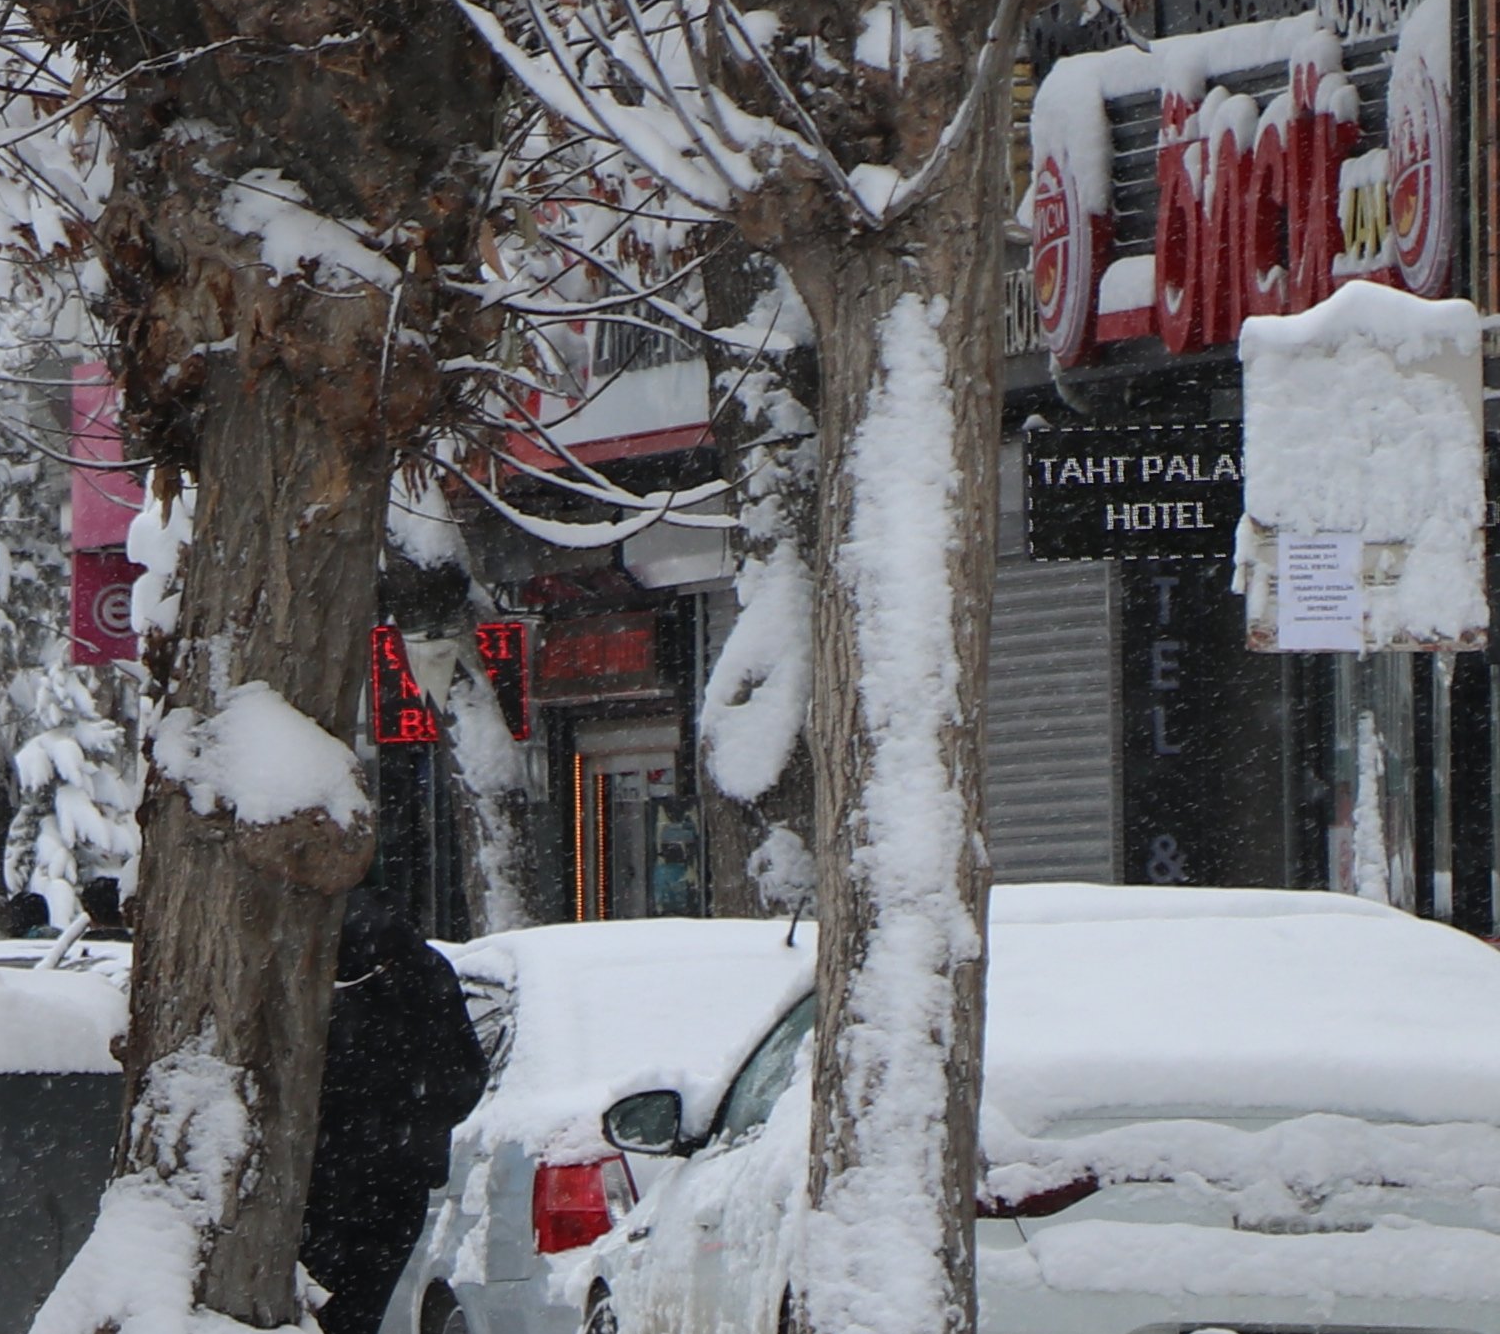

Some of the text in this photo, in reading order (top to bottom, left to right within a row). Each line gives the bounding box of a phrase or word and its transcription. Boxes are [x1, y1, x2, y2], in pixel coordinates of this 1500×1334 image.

[1039, 453, 1245, 485] TAHT PALA
[1106, 501, 1215, 531] HOTEL
